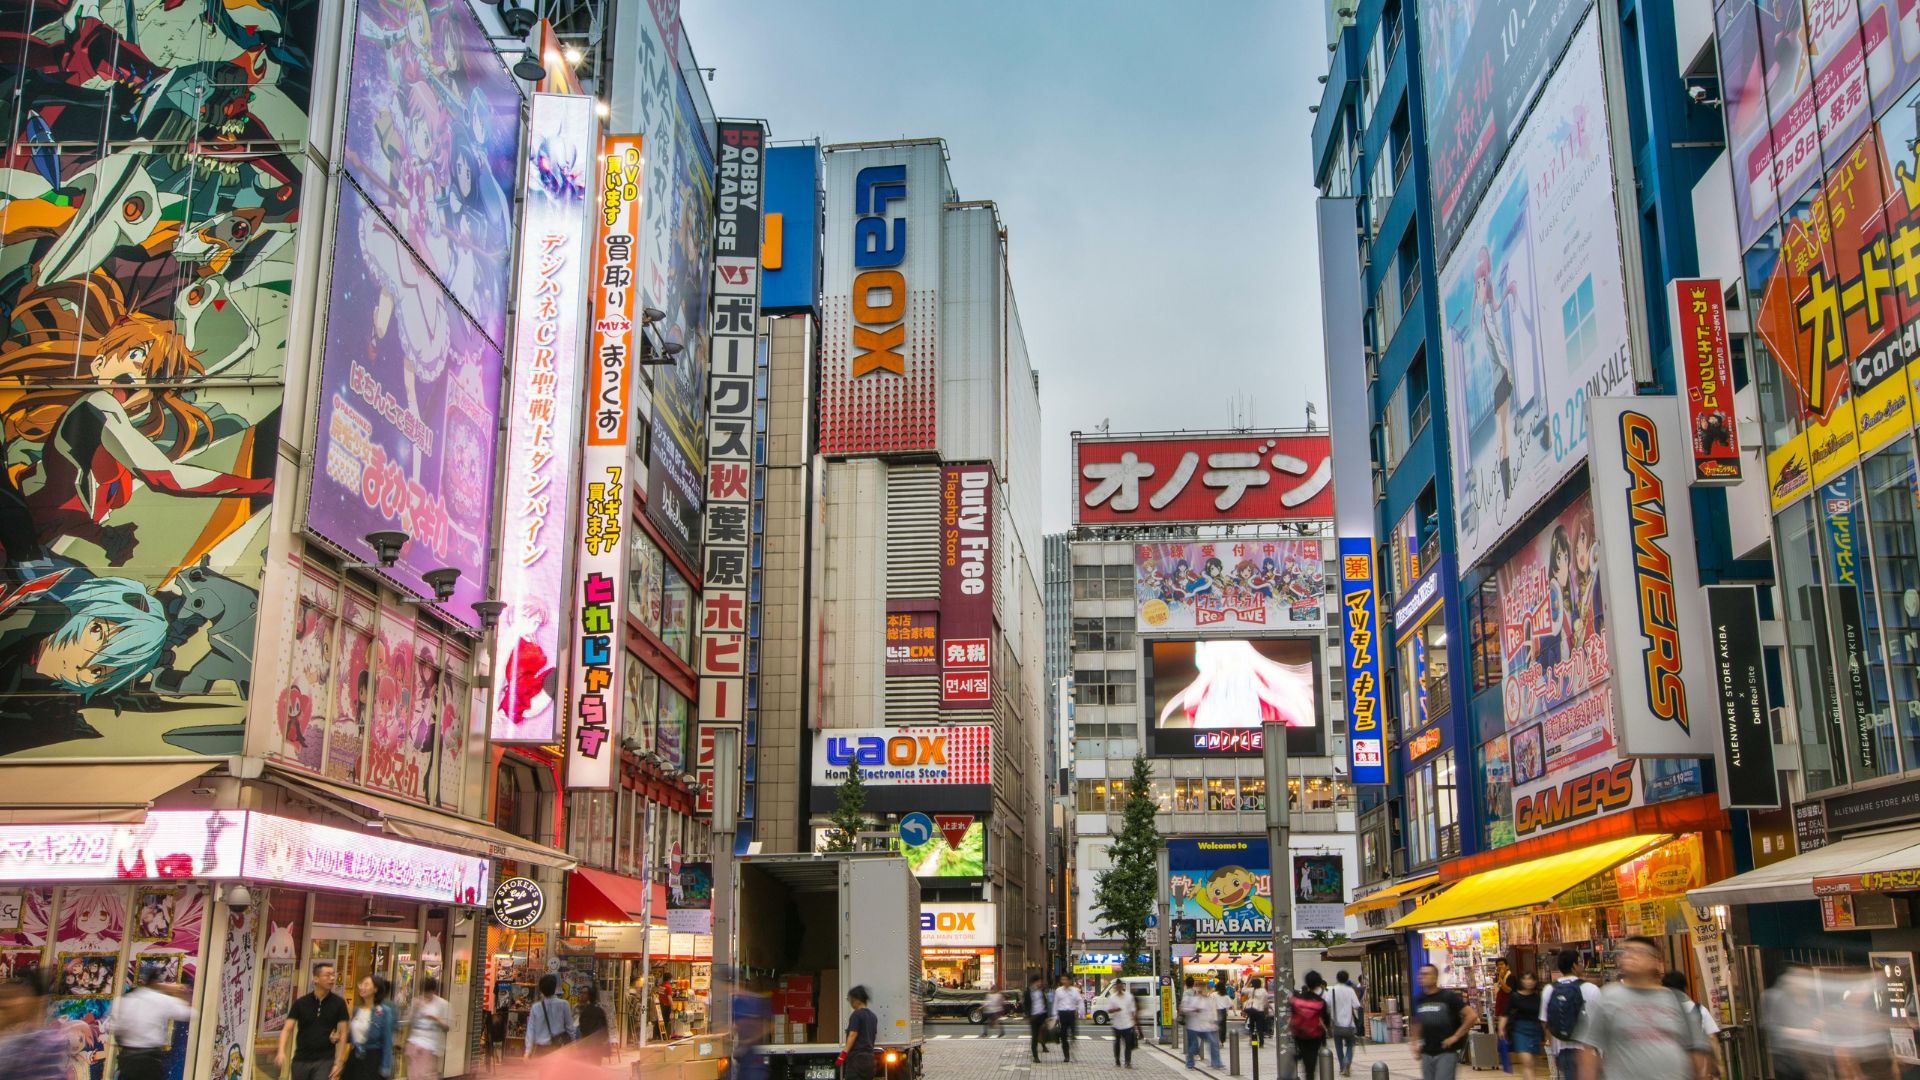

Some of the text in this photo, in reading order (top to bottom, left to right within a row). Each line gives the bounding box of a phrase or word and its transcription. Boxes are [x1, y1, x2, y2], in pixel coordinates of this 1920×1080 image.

[603, 155, 622, 226] 買います
[623, 148, 639, 202] DVD
[718, 129, 740, 251] PARADISE
[739, 129, 760, 211] HOBBY
[604, 234, 632, 308] 買取り
[598, 344, 624, 433] まっくす
[1602, 344, 1629, 395] SALE
[1692, 300, 1719, 409] カードキングダム
[1856, 323, 1916, 389] card
[602, 466, 622, 553] フィギュア
[1083, 439, 1332, 511] オノデン
[585, 482, 605, 556] 買います
[944, 472, 959, 567] Flagship Store
[958, 471, 989, 595] Duty Free
[1618, 409, 1691, 738] GAMERS
[887, 614, 912, 627] 本店
[947, 644, 986, 662] 免税
[577, 571, 616, 760] とれじゃらす
[946, 679, 987, 693] 면세점
[1719, 625, 1742, 767] ALIENWARE STORE AKIBA
[1748, 665, 1762, 726] Dell Real Site
[825, 768, 947, 780] Hom Electronics Store
[1194, 731, 1263, 750] ANIPLE
[942, 822, 966, 830] 止まれ
[1514, 758, 1637, 836] GAMERS
[1834, 792, 1920, 817] ALIENWARE STORE AKIB
[1198, 842, 1248, 850] Welcome to
[497, 908, 538, 926] VAPE STAND
[498, 879, 540, 898] SMOKER'S
